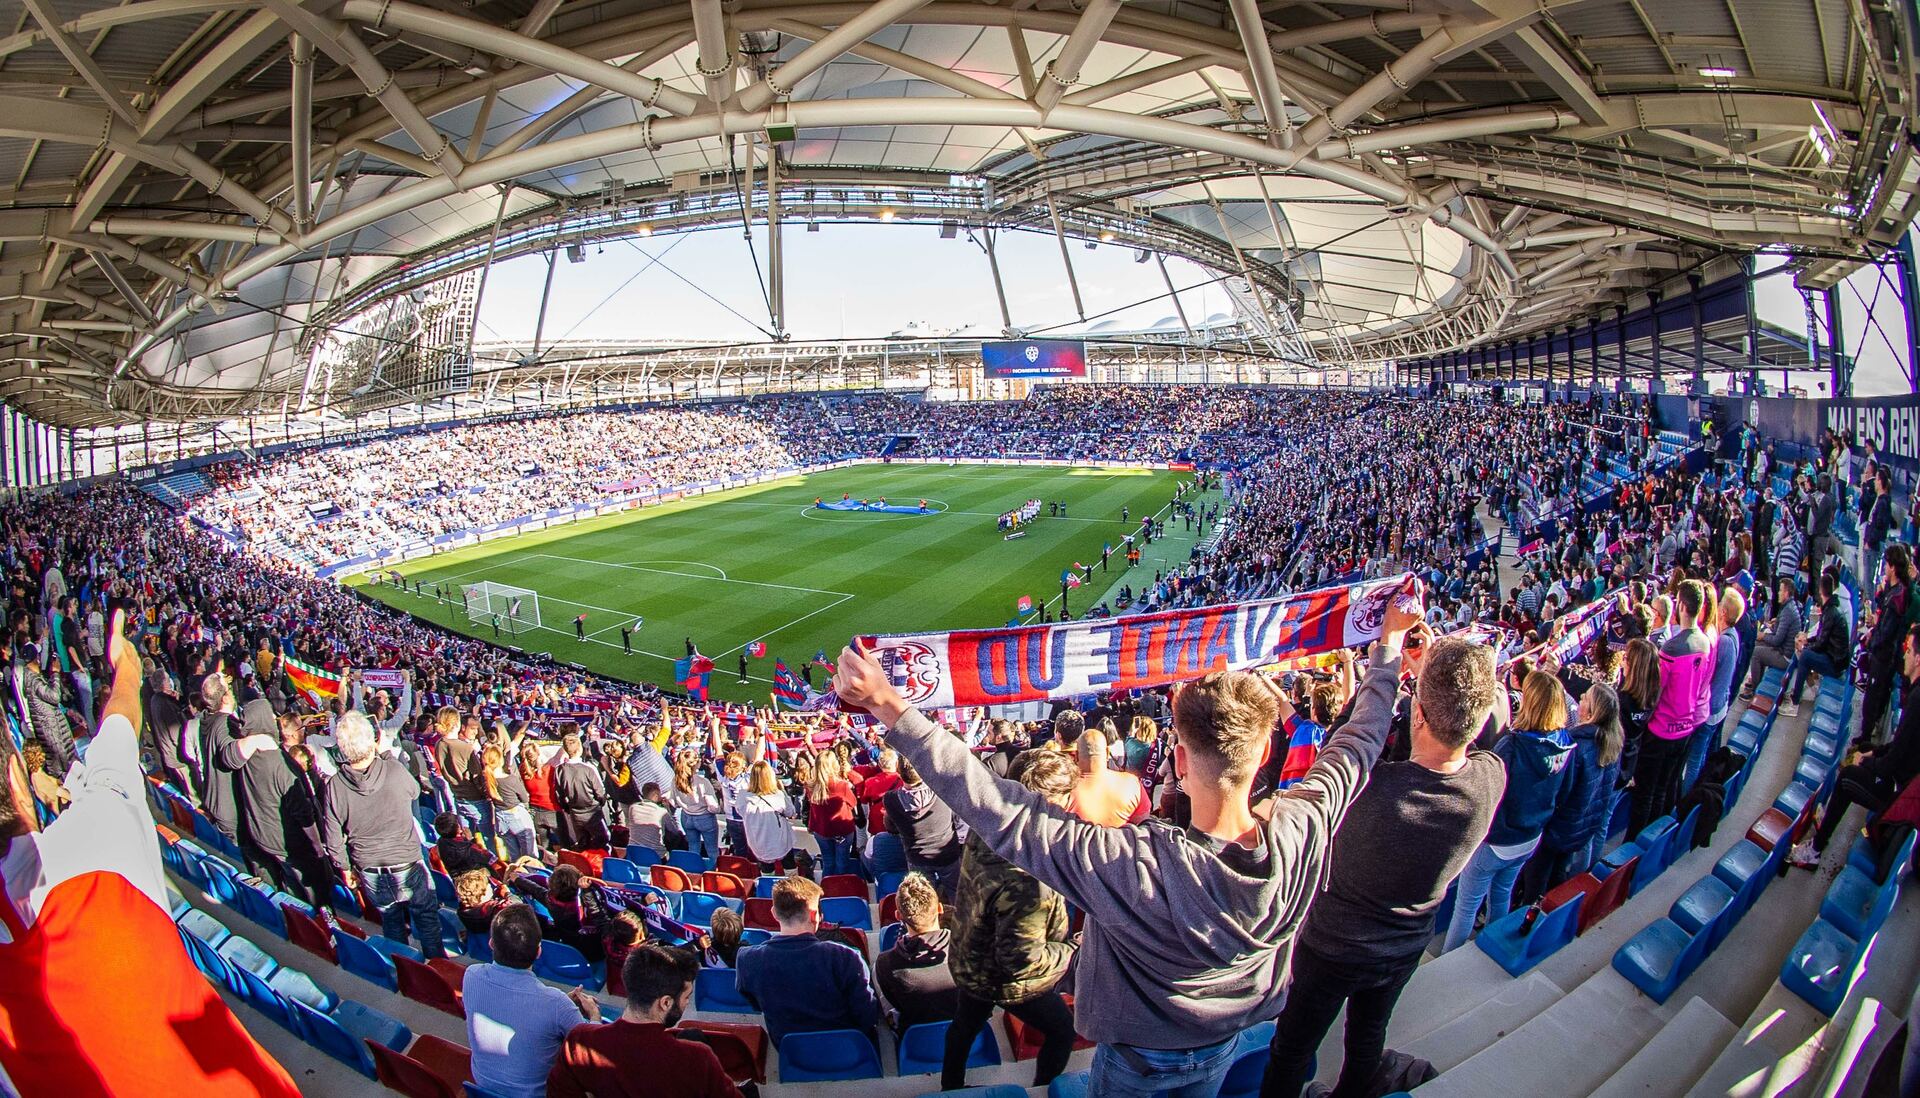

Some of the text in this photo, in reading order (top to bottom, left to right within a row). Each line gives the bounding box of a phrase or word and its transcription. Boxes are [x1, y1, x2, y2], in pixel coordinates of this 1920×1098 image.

[296, 429, 386, 449] L'EQUIP DELS VALENCIANS
[1855, 406, 1885, 452] ENS
